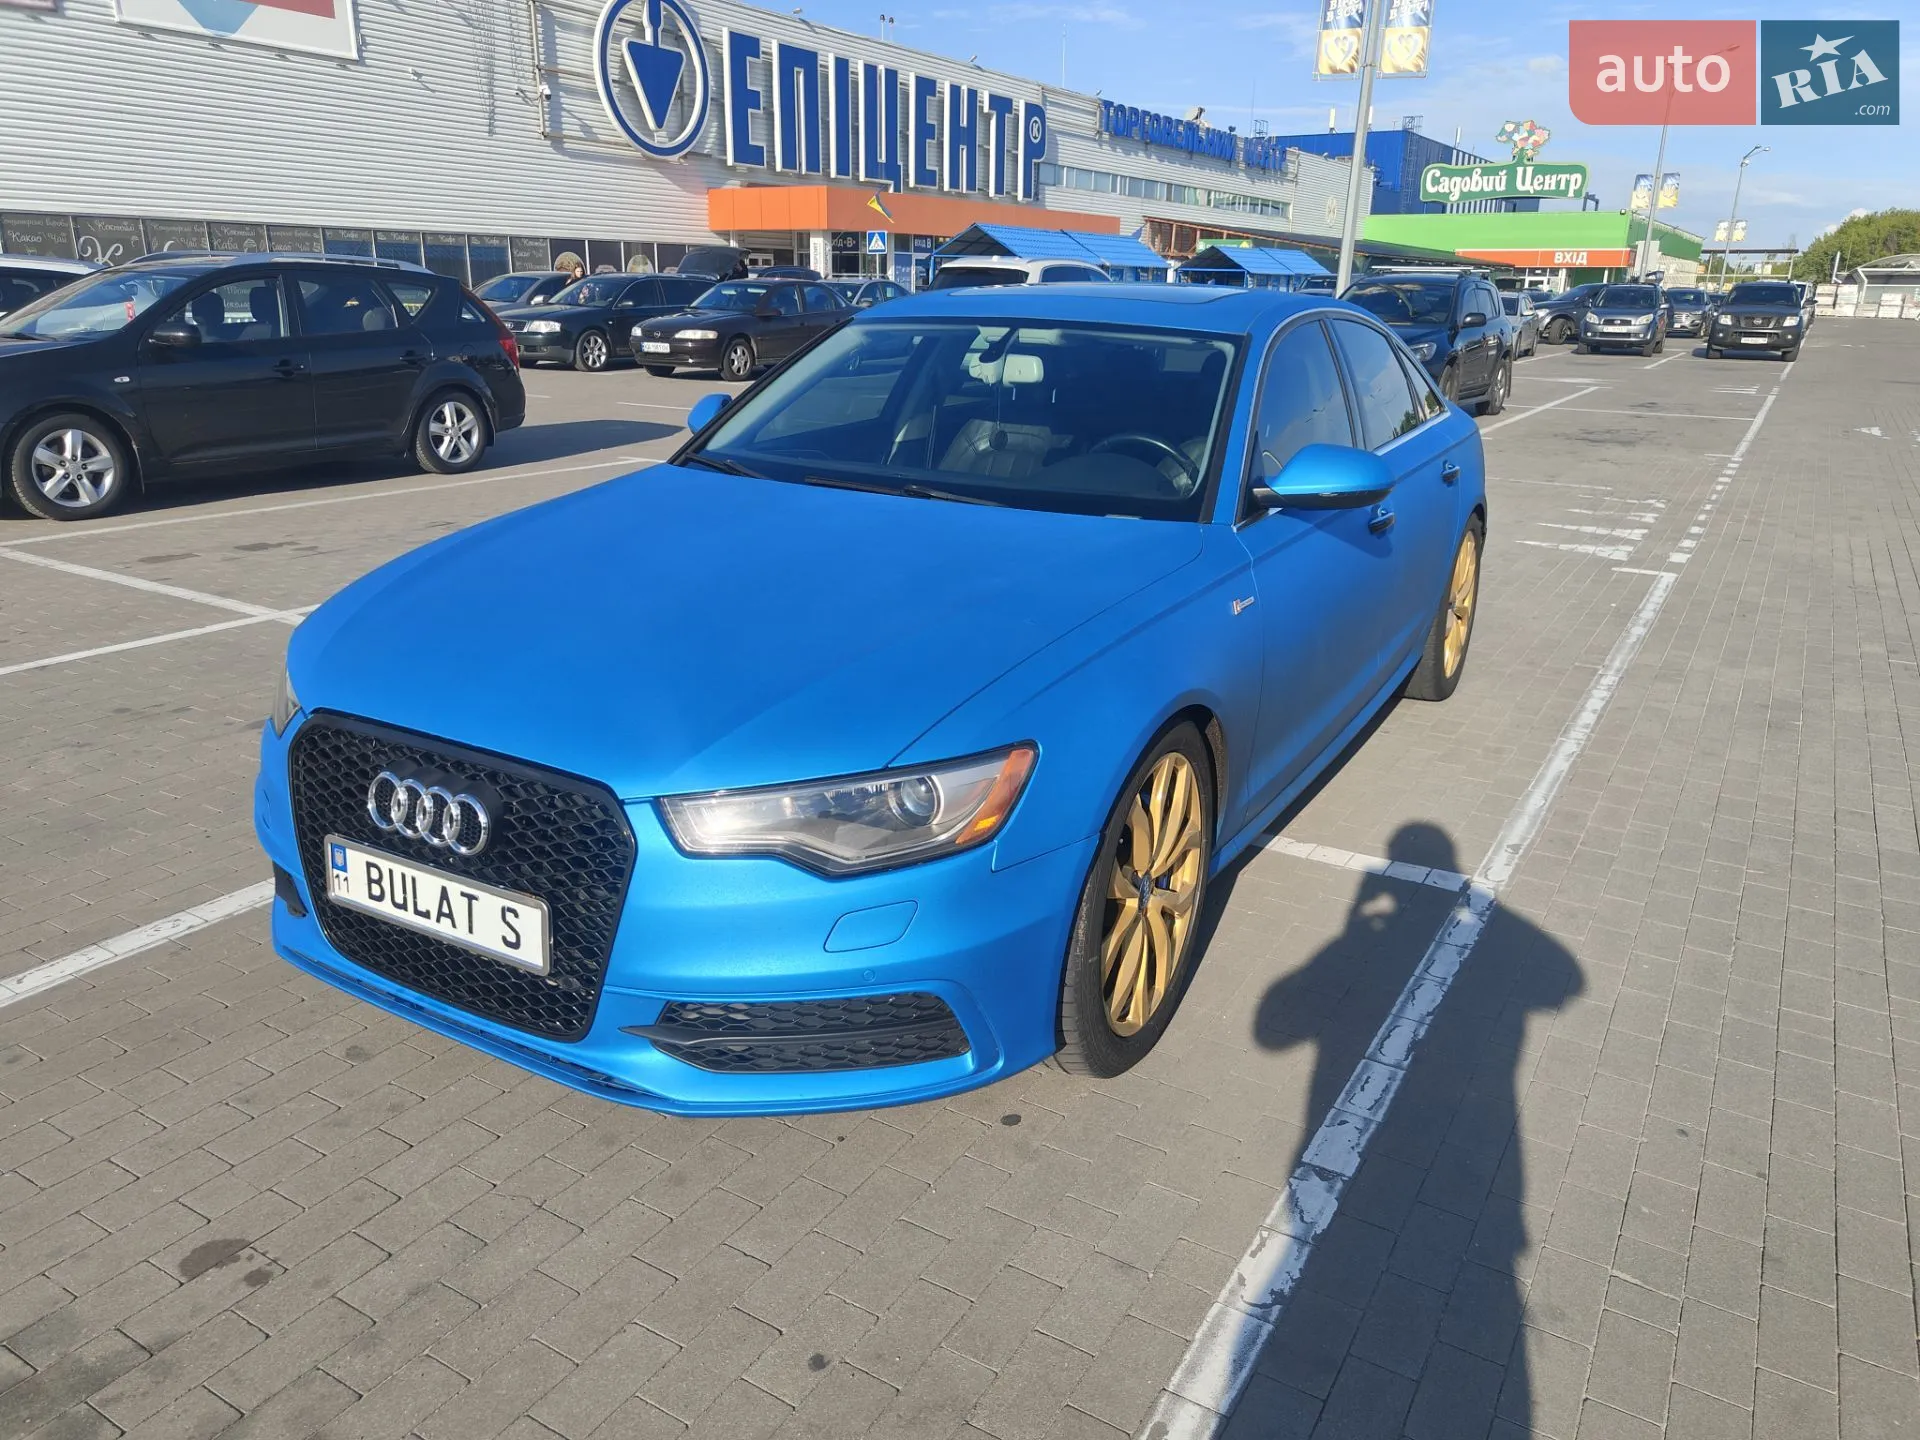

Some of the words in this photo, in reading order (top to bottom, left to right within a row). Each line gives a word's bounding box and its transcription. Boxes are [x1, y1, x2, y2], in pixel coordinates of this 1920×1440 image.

[722, 27, 1048, 202] ЕПІЦЕНТР
[1103, 99, 1237, 161] ТОРГОВЕЛЬНИЙ
[1425, 168, 1508, 201] Садовий
[1516, 166, 1583, 198] Центр
[8, 230, 42, 243] Какао
[1554, 251, 1588, 265] ВХІД
[334, 873, 349, 894] 11
[365, 860, 479, 935] BULAT
[501, 904, 521, 950] S
